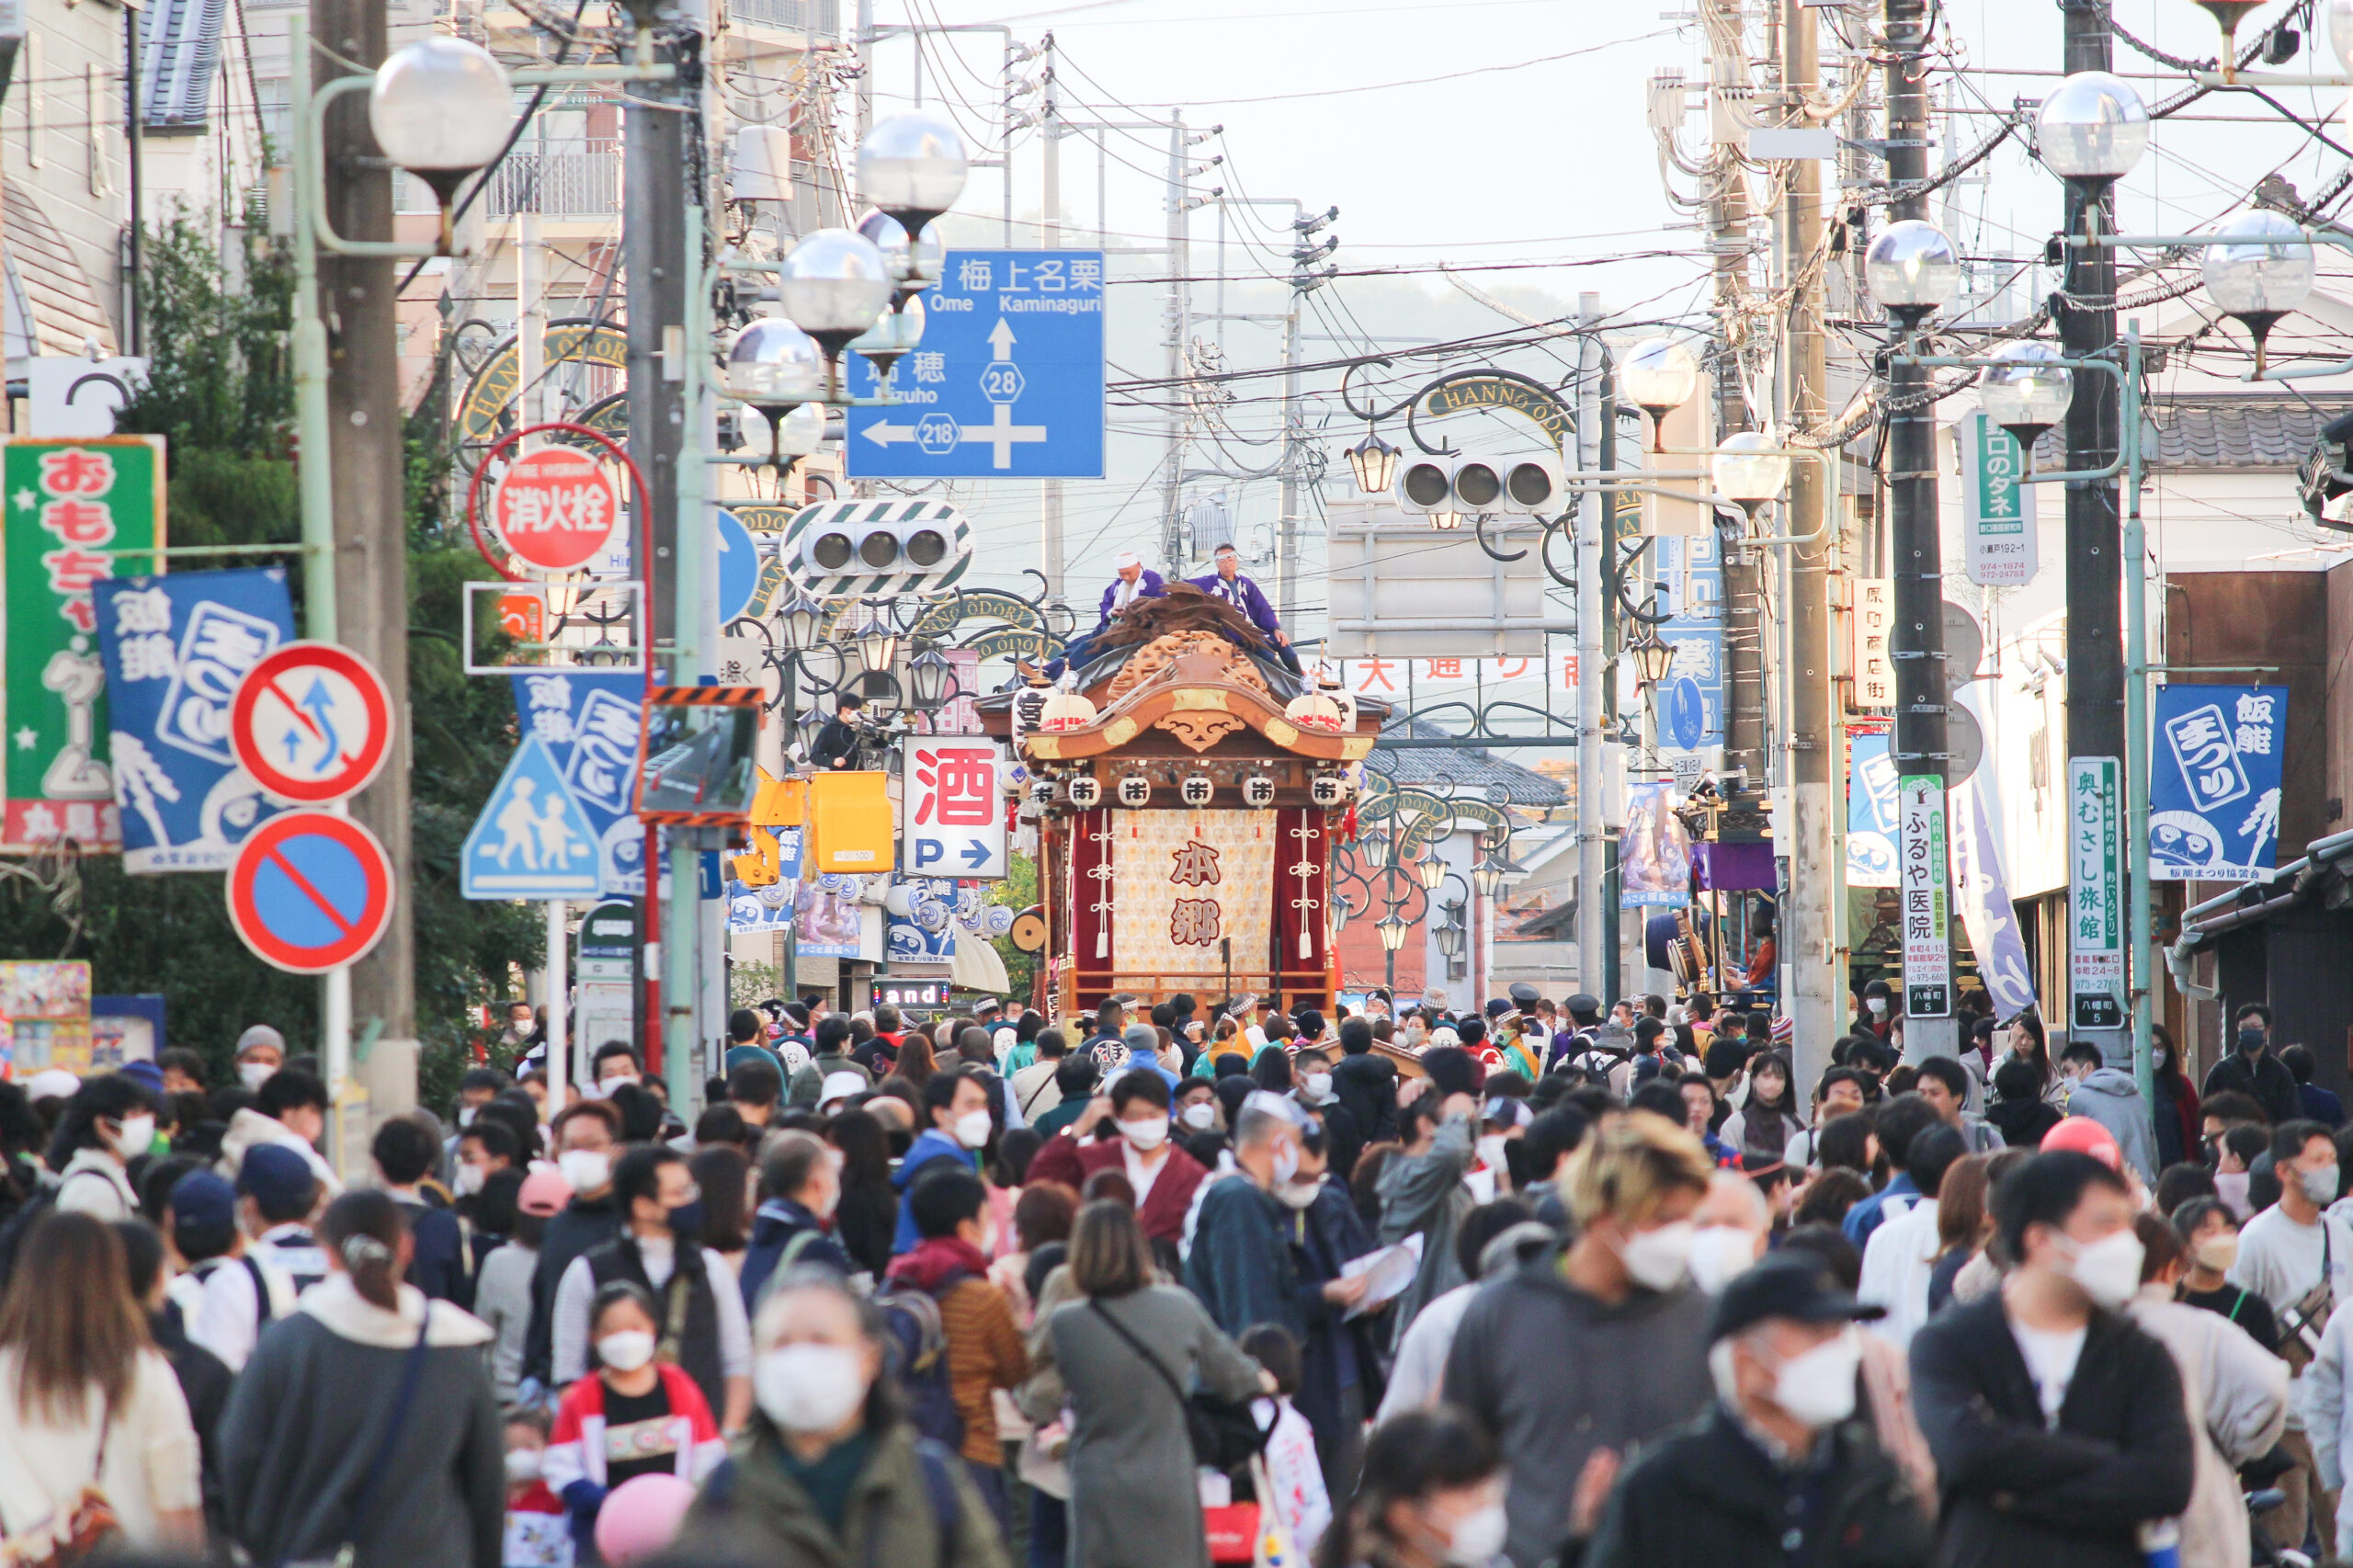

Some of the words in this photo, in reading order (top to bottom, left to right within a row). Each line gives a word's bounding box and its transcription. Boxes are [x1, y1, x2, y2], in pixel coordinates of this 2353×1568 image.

[999, 259, 1102, 291] 上名栗
[930, 294, 974, 312] Ome
[999, 294, 1102, 314] Kaminaguri
[988, 371, 1017, 393] 28
[922, 424, 953, 444] 218
[506, 483, 608, 533] 消火栓
[1866, 586, 1885, 699] 原町商店街
[2235, 693, 2276, 755] 飯能
[2176, 716, 2235, 798] まつり
[915, 748, 995, 825] 酒
[915, 839, 944, 868] P
[2077, 771, 2105, 939] 奥むさし旅館
[1906, 812, 1931, 939] ふるや医院
[1170, 840, 1221, 947] 本郷
[885, 985, 937, 1004] and
[1915, 992, 1941, 1000] 八幡町
[1925, 1002, 1931, 1011] 5
[2082, 1000, 2113, 1010] 八幡町
[2093, 1013, 2101, 1023] 5
